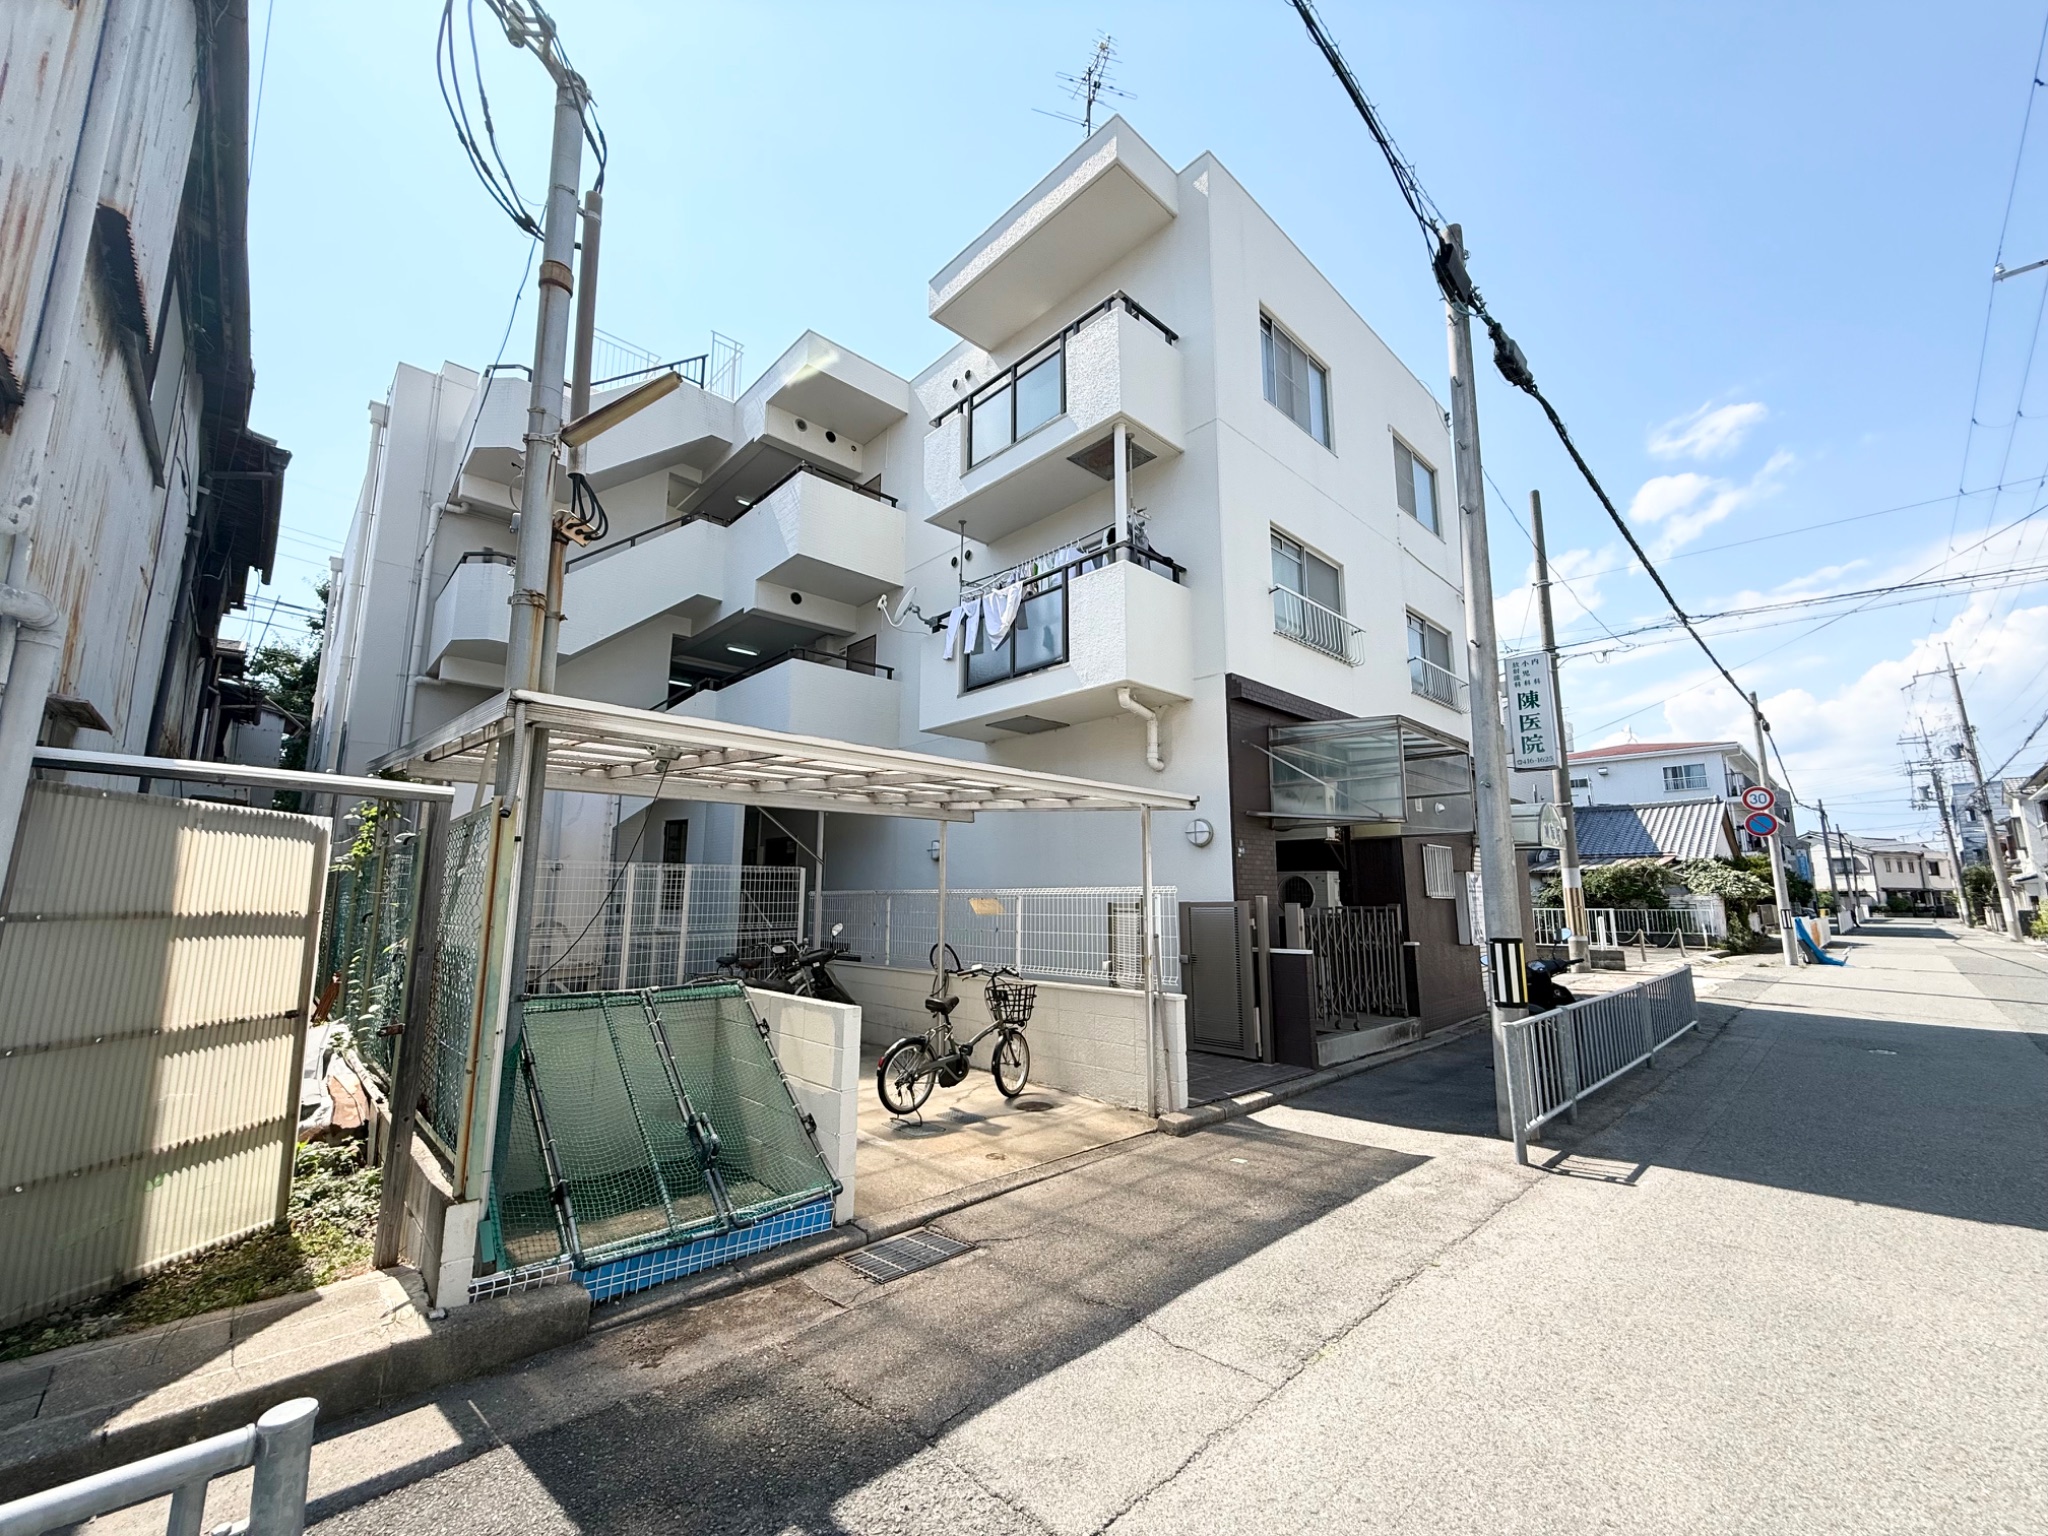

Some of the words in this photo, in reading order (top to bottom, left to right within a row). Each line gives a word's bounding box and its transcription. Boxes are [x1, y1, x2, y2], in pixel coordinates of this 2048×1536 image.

[1517, 690, 1546, 755] 陳医院
[1749, 793, 1767, 805] 30
